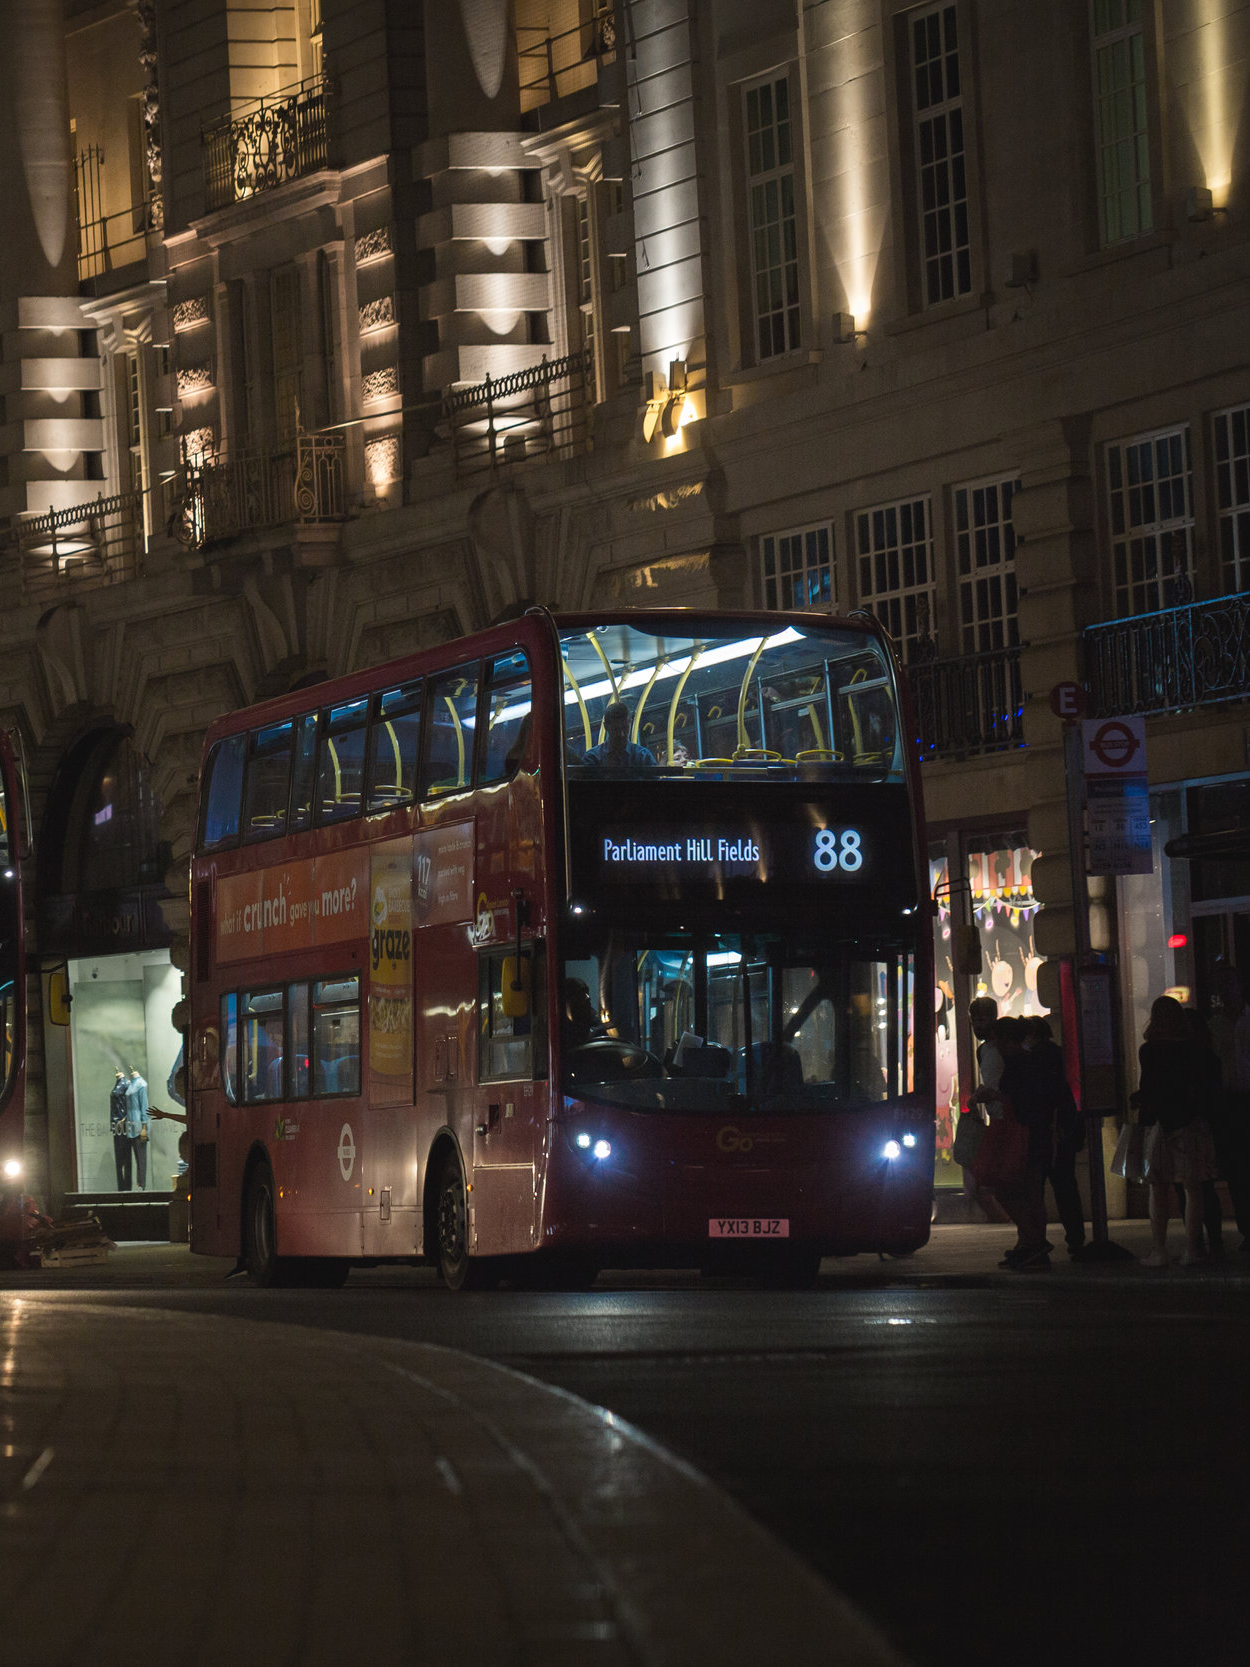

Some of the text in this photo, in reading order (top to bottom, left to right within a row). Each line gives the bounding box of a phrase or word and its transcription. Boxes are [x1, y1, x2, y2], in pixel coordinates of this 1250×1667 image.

[1059, 687, 1078, 713] E
[603, 829, 863, 872] Parliament Hill Fields 88
[417, 854, 431, 885] 117
[220, 911, 235, 936] what
[236, 909, 242, 932] if
[243, 883, 287, 932] crunch
[290, 901, 308, 927] gave
[321, 877, 357, 917] more?
[372, 929, 411, 971] graze
[716, 1126, 754, 1151] Go
[717, 1221, 781, 1234] YX13 BJZ
